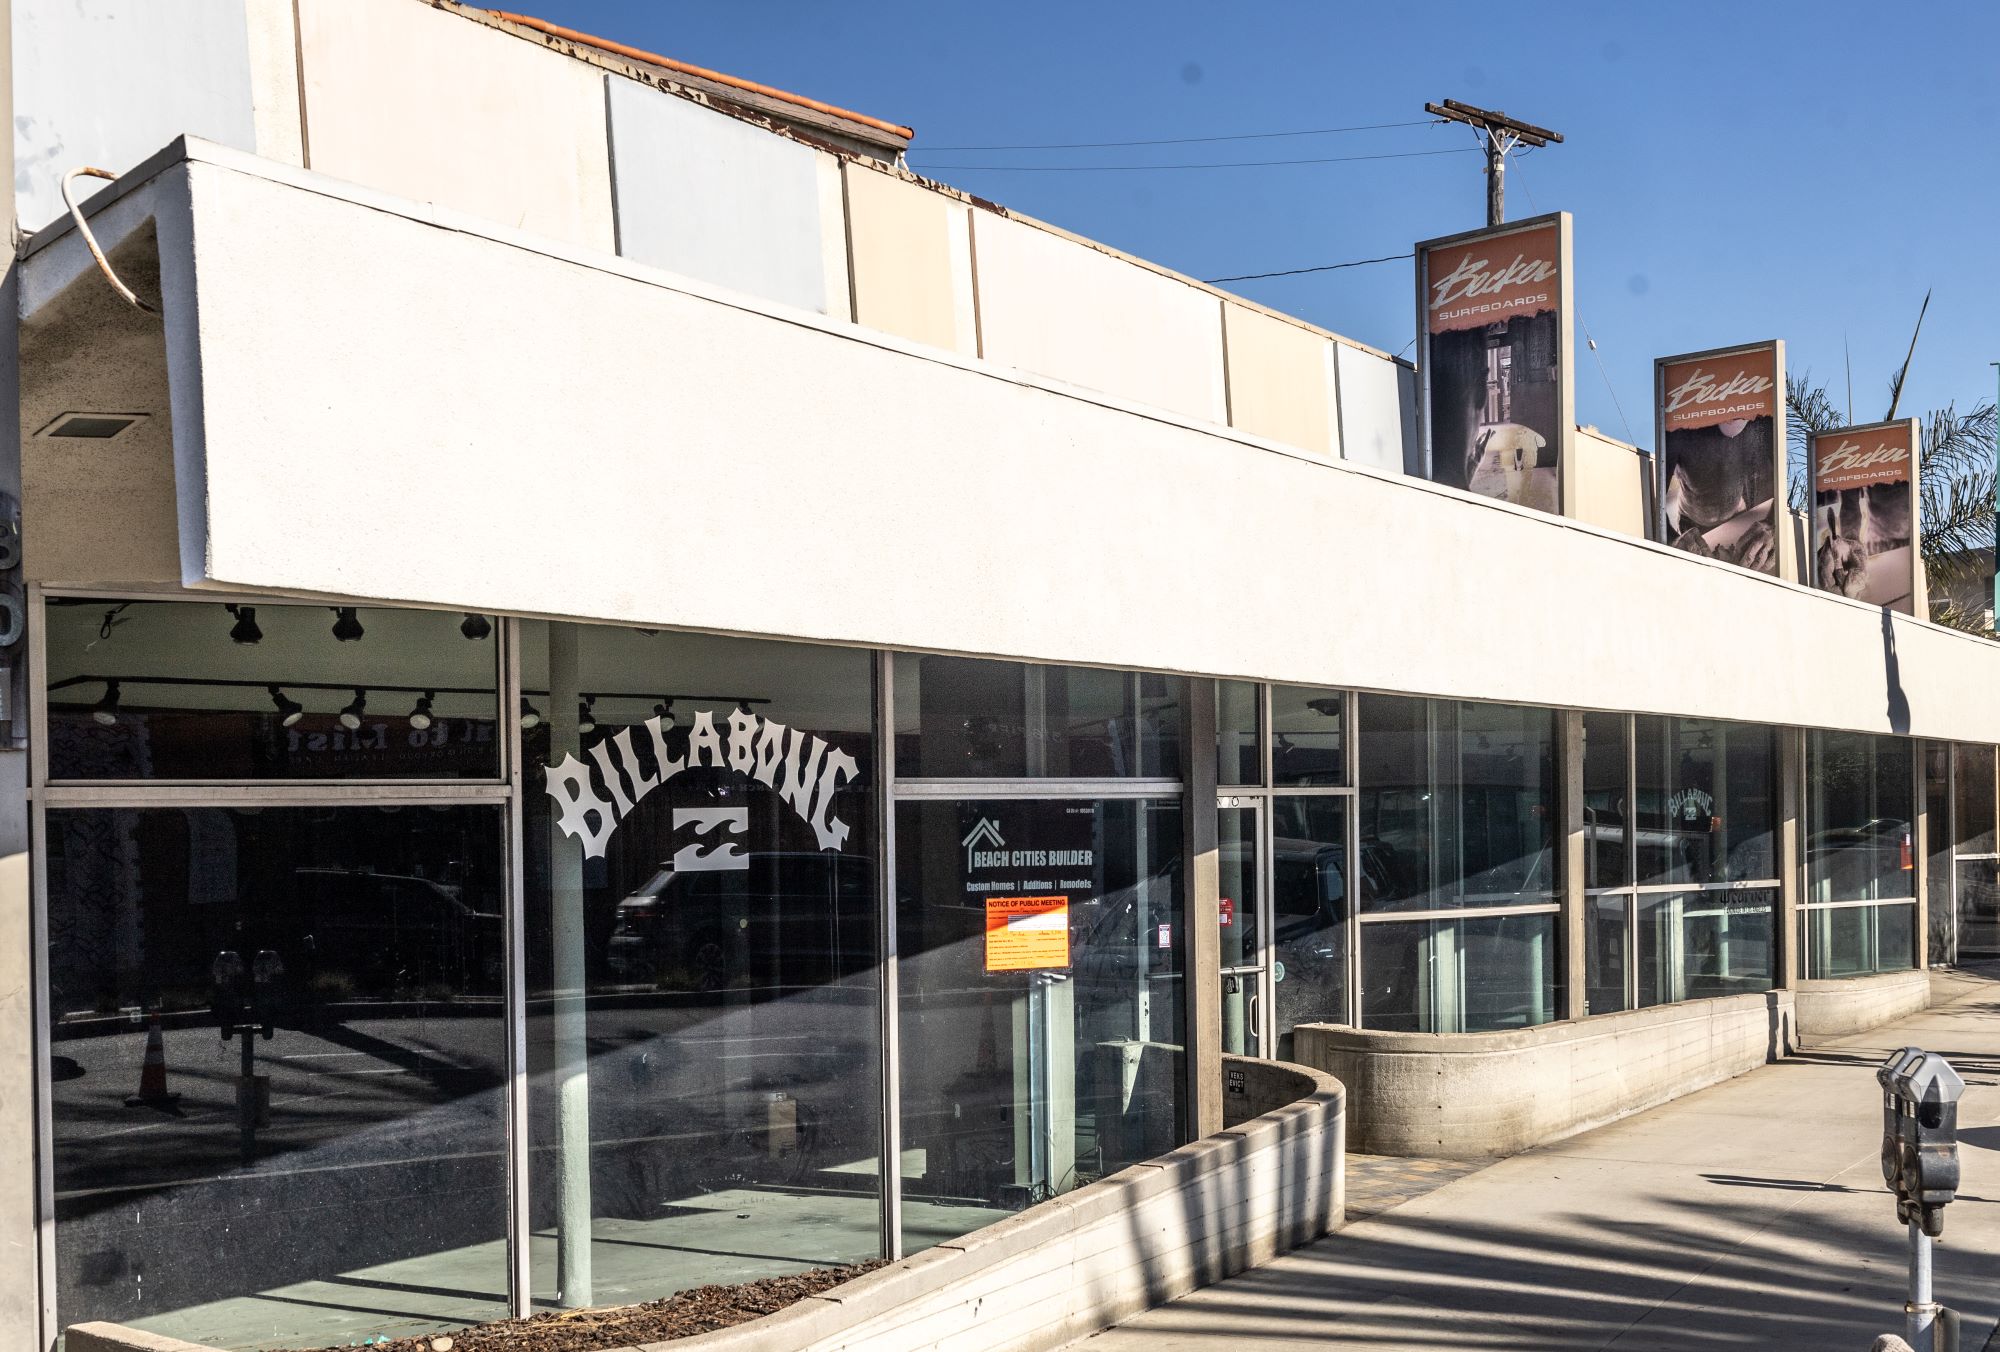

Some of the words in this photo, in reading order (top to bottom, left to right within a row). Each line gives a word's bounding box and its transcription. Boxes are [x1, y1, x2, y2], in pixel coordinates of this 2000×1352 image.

[1429, 253, 1556, 310] Becker
[1439, 294, 1547, 320] SURFBOARDS
[1665, 368, 1773, 412] Becker
[1673, 402, 1765, 421] SURFBOARDS
[1817, 440, 1909, 476] Becker
[1824, 469, 1902, 484] SURFBOARDS
[544, 707, 860, 860] BILLABONG
[1668, 787, 1713, 818] BILLABONG
[974, 851, 1009, 868] BEACH
[1012, 850, 1047, 867] CITIES
[1049, 850, 1093, 866] BUILDER
[966, 882, 990, 892] Custom
[991, 881, 1015, 891] Homes
[1023, 880, 1052, 890] Additions
[1059, 879, 1092, 889] Remodels
